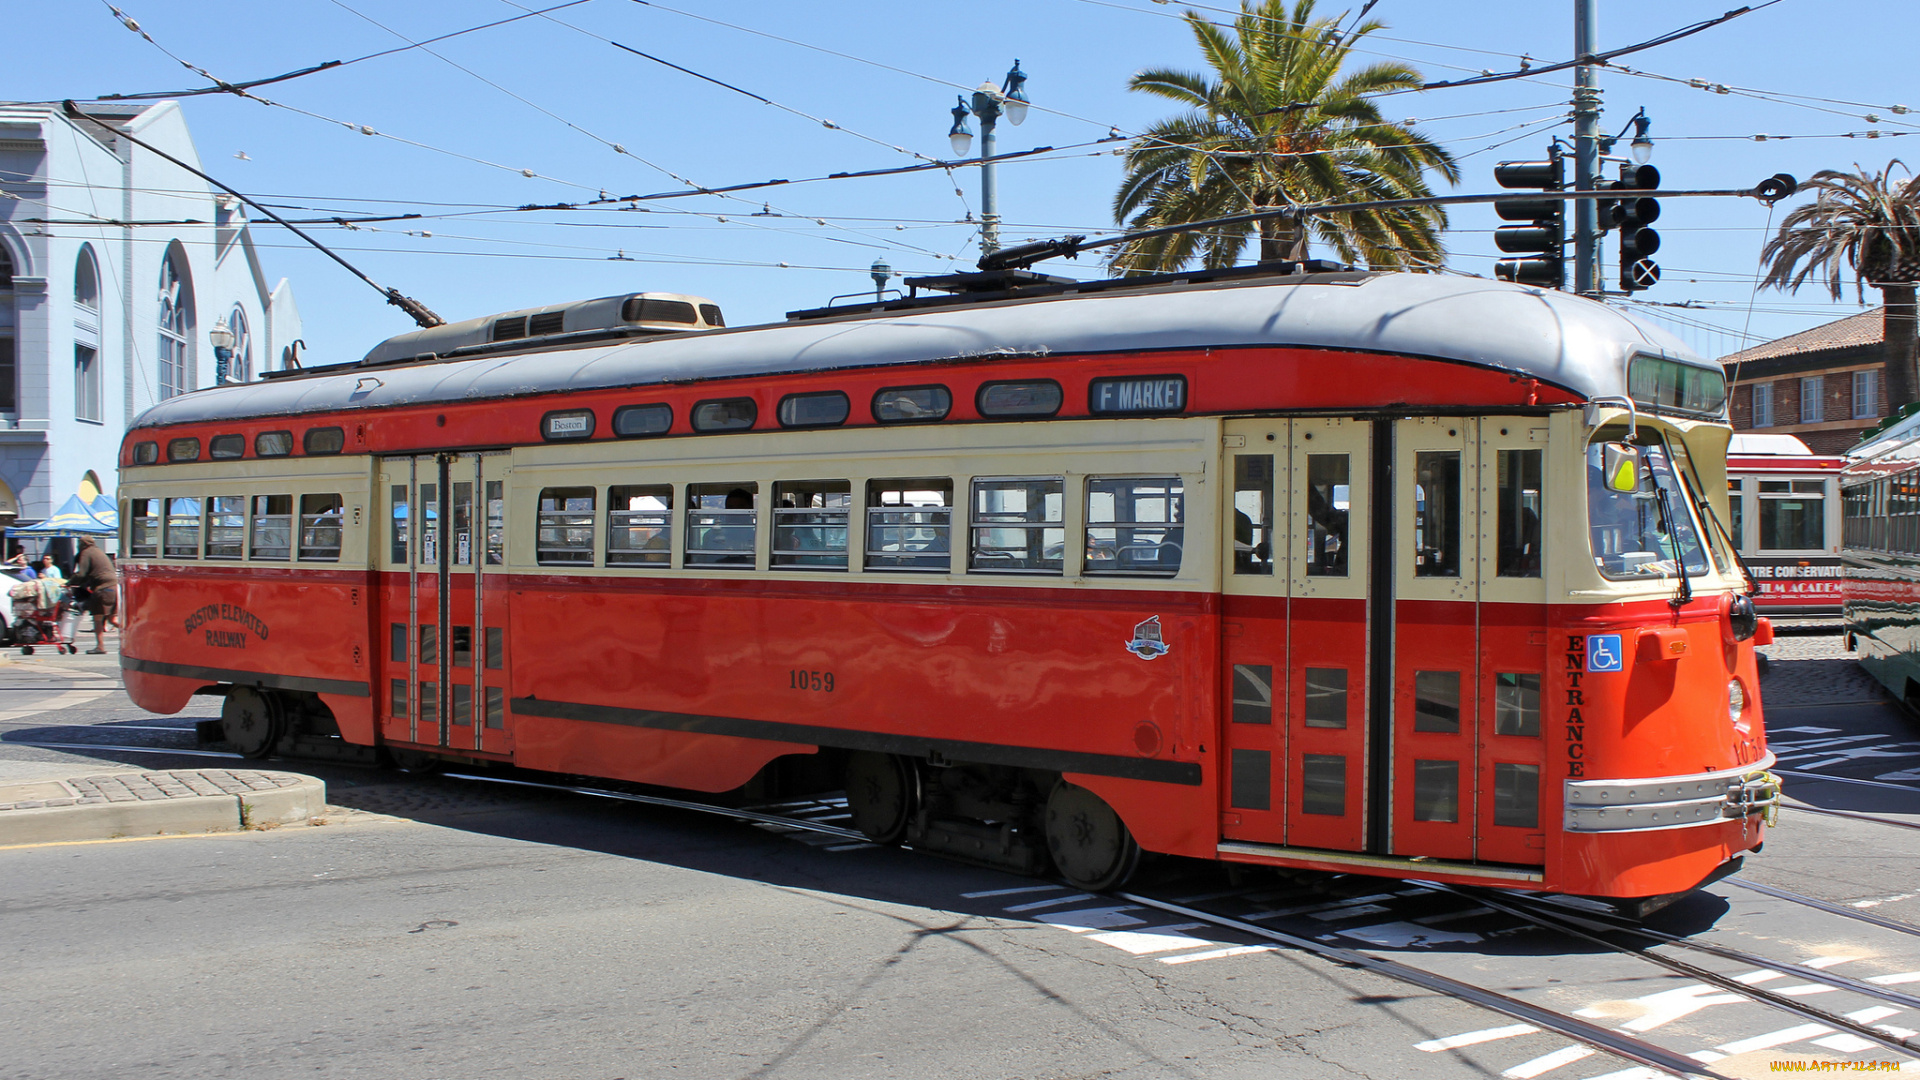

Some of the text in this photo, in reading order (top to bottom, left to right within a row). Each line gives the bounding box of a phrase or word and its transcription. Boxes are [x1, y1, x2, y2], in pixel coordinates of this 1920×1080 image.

[1101, 380, 1184, 410] F MARKET
[554, 420, 582, 430] Boston
[184, 604, 269, 641] BOSTON ELEVATED
[206, 629, 247, 649] RAILWAY
[789, 669, 835, 693] 1059
[1566, 635, 1584, 777] ENTRANCE
